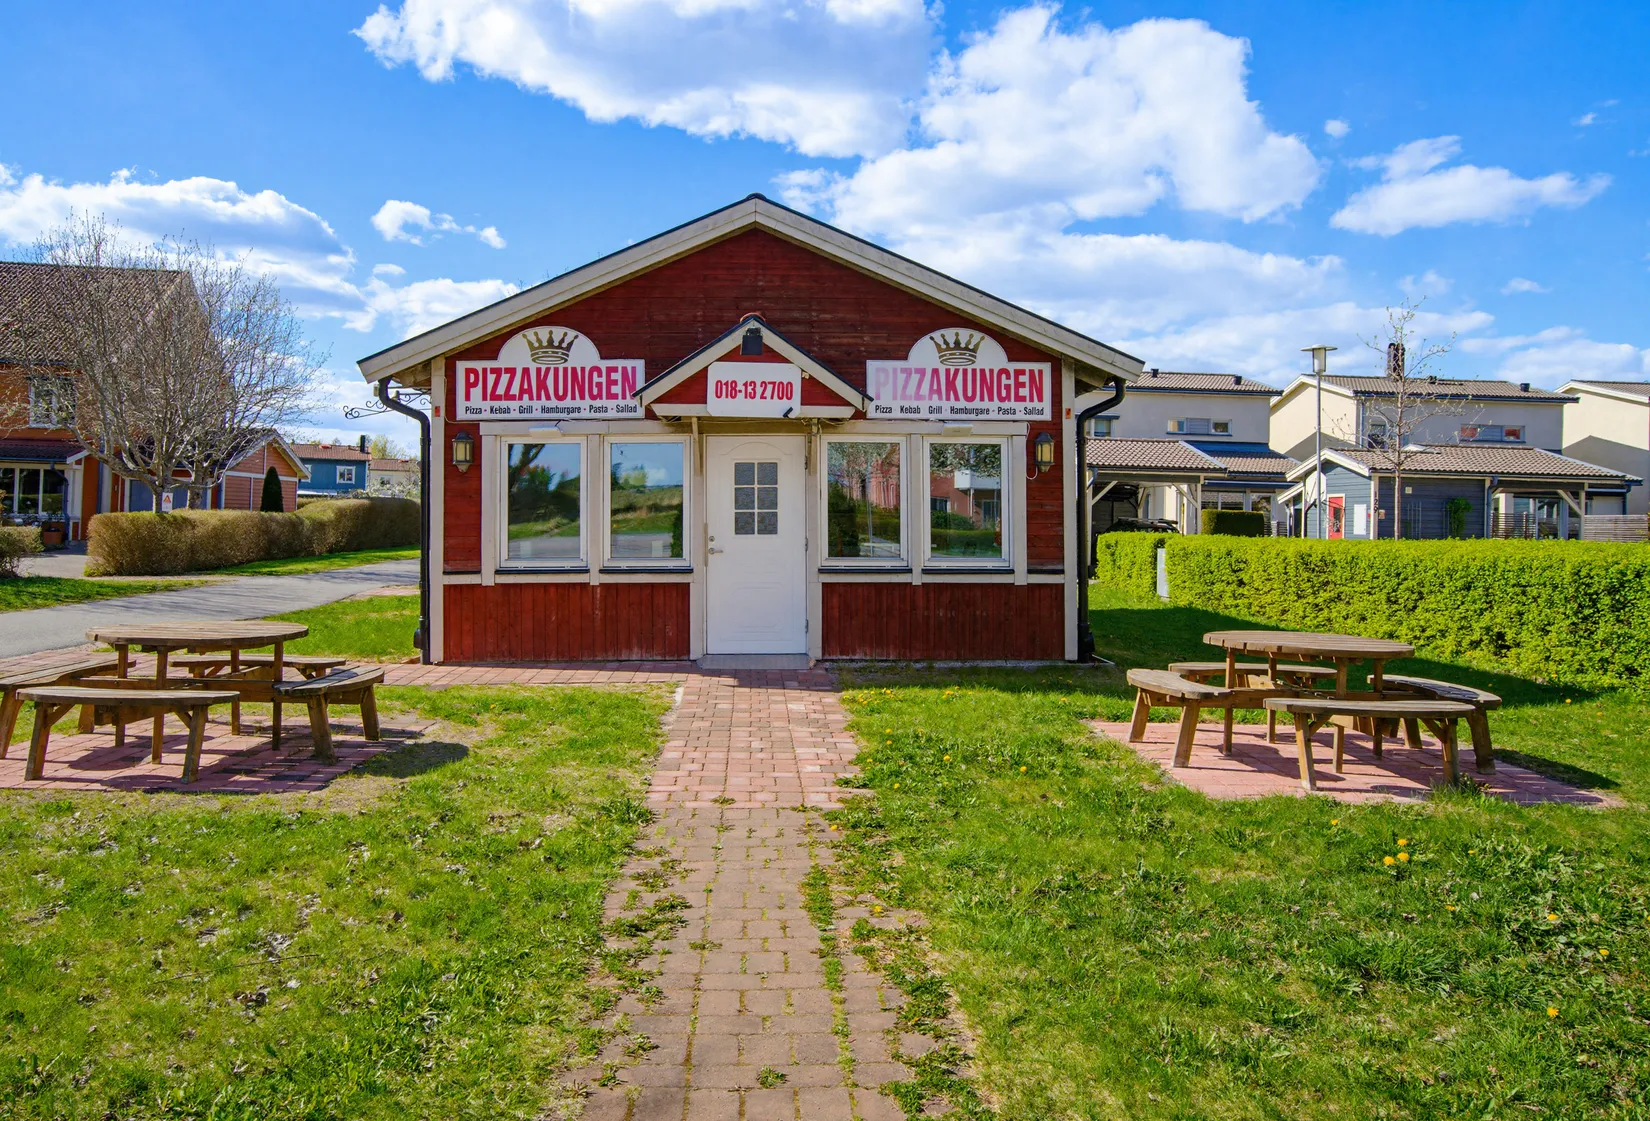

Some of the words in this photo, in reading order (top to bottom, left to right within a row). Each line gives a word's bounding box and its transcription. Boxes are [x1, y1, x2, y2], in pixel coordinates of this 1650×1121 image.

[464, 365, 637, 402] PIZZAKUNGEN
[715, 380, 757, 399] 018-13
[760, 381, 793, 400] 2700
[874, 367, 1044, 403] PIZZAKUNGEN
[465, 406, 483, 415] Pizza
[489, 406, 512, 415] Kebab
[518, 405, 534, 414] Grill
[541, 405, 581, 415] Hamburgare
[589, 404, 608, 414] Pasta
[616, 404, 637, 413] Sallad
[875, 405, 893, 414] Pizza
[900, 405, 921, 415] Kebab
[928, 405, 943, 415] Grill
[950, 406, 990, 417] Hamburgare
[997, 406, 1017, 415] Pasta
[1024, 407, 1044, 416] Sallad
